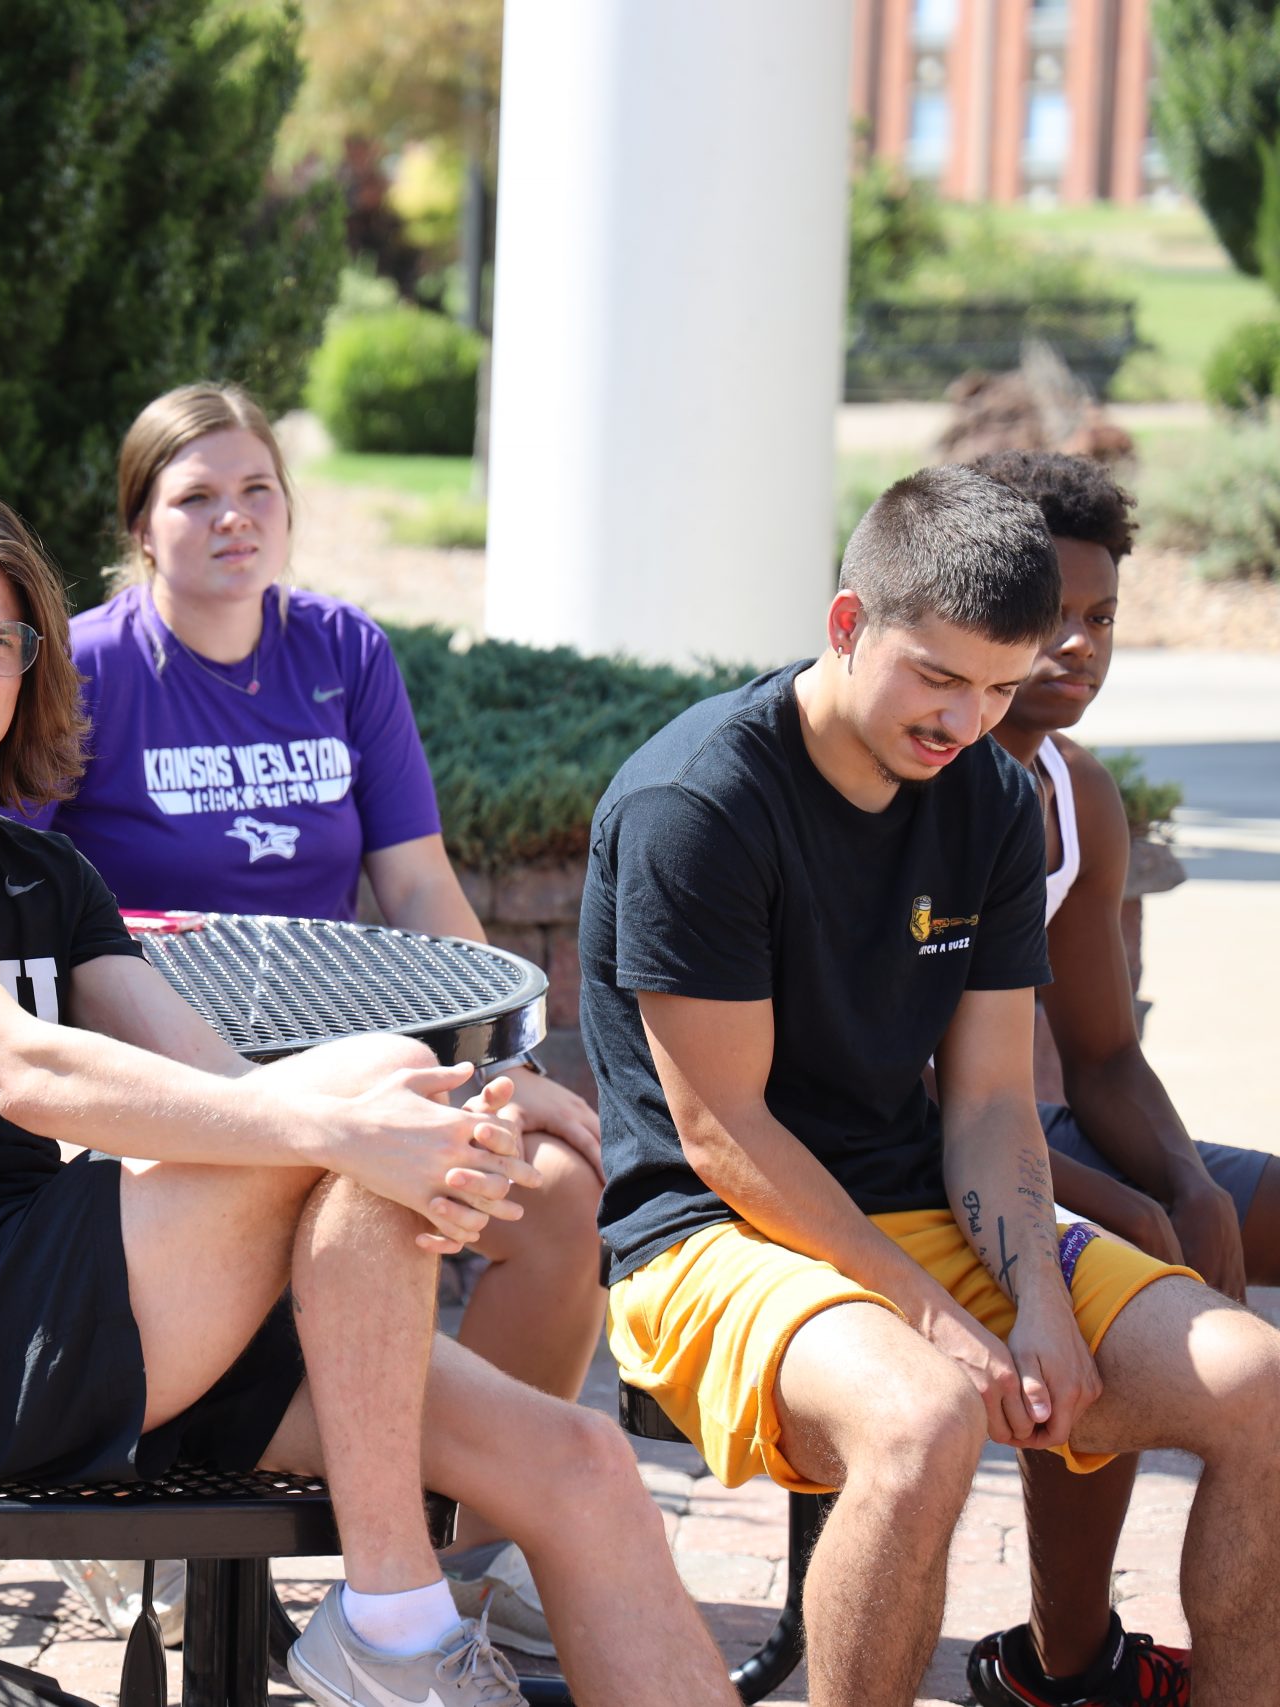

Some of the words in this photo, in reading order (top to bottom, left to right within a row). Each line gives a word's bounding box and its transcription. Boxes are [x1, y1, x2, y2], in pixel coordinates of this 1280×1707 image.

[144, 746, 234, 790] KANSAS
[233, 737, 352, 785] WESLEYAN
[940, 944, 946, 952] A
[948, 937, 970, 950] BUZZ
